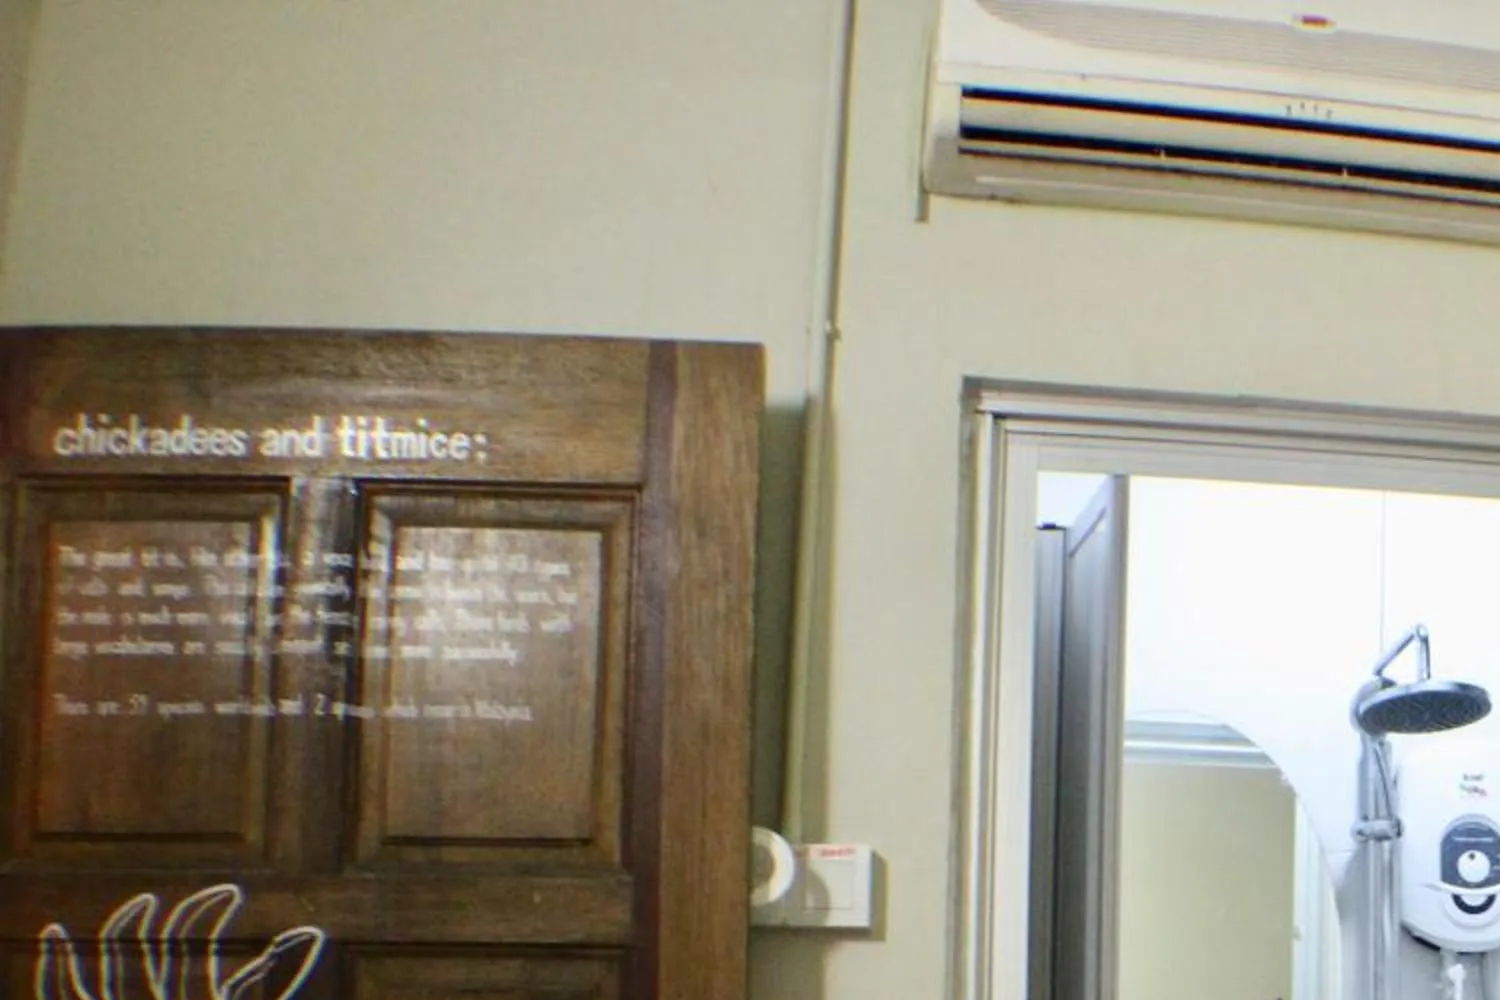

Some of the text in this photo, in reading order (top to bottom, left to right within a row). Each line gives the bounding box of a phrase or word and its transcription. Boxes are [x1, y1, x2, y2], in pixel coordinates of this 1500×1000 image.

[54, 413, 488, 463] chickadees and titmice:
